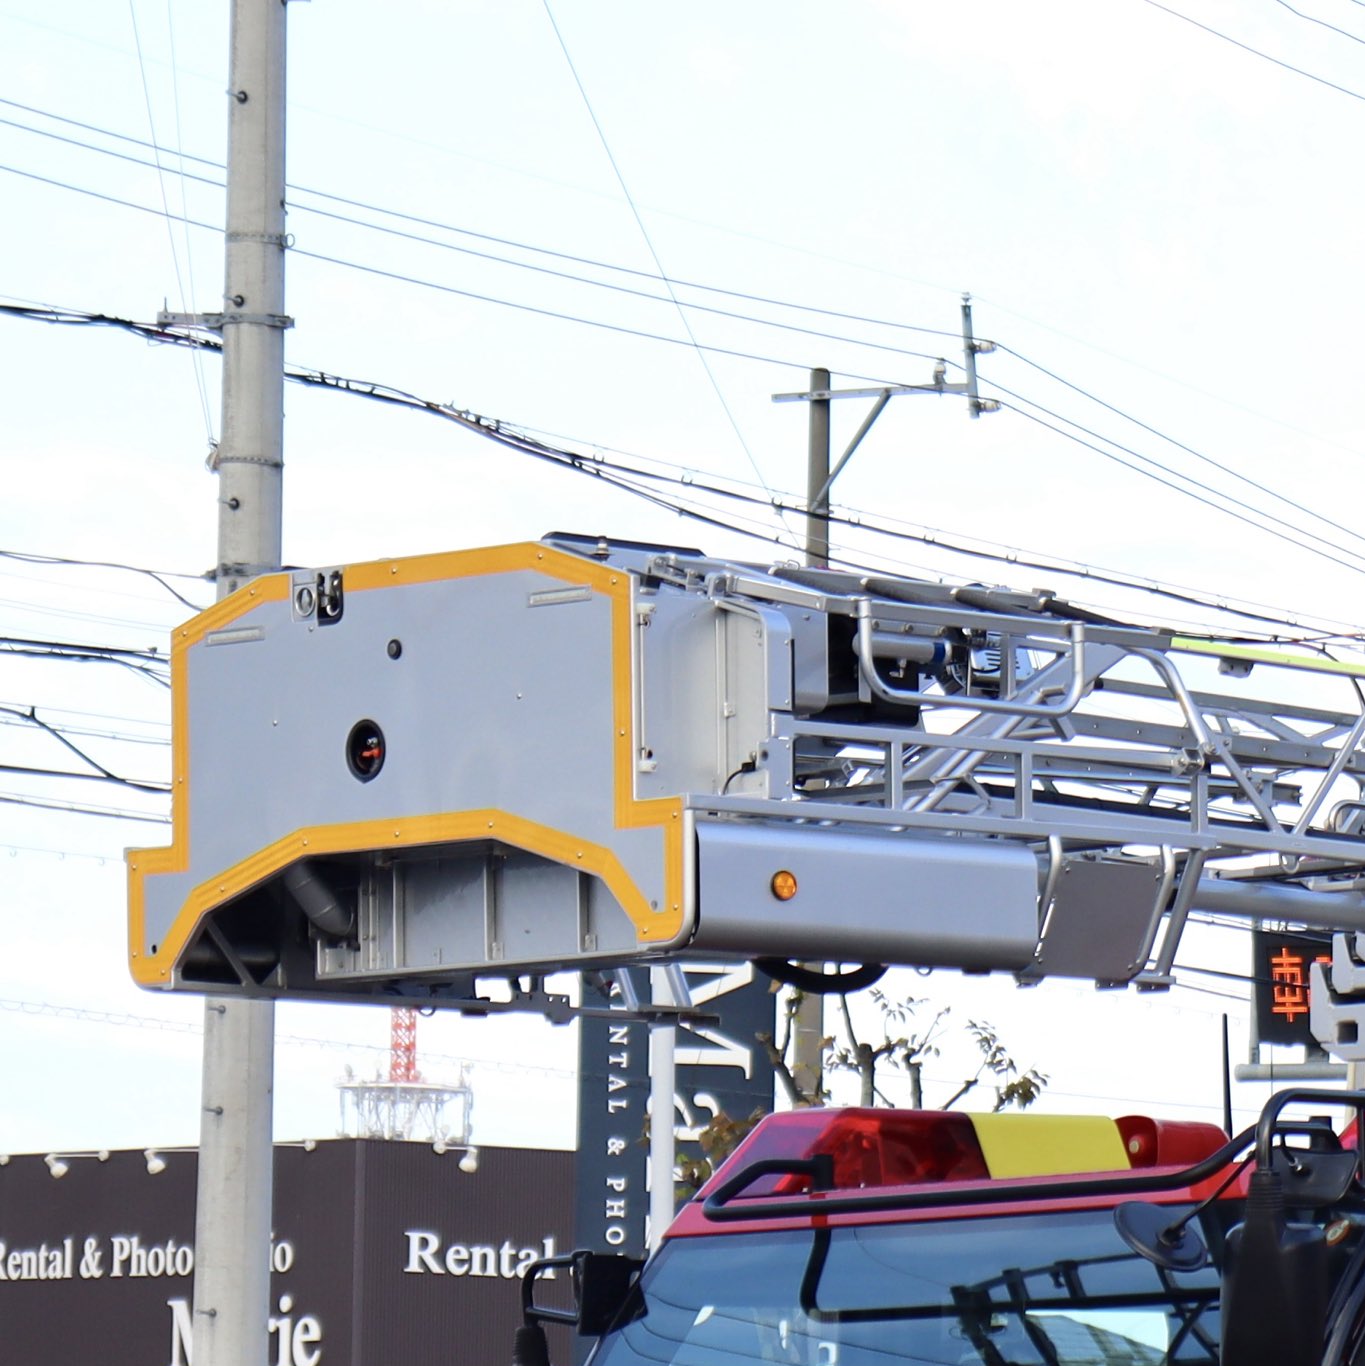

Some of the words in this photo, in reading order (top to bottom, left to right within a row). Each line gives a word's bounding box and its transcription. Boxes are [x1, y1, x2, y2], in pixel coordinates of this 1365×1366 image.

[1272, 947, 1332, 1022] 車
[607, 1137, 626, 1156] &
[605, 1176, 625, 1256] PHO
[79, 1237, 103, 1279] &
[110, 1235, 194, 1277] Photo
[404, 1231, 557, 1280] Rental
